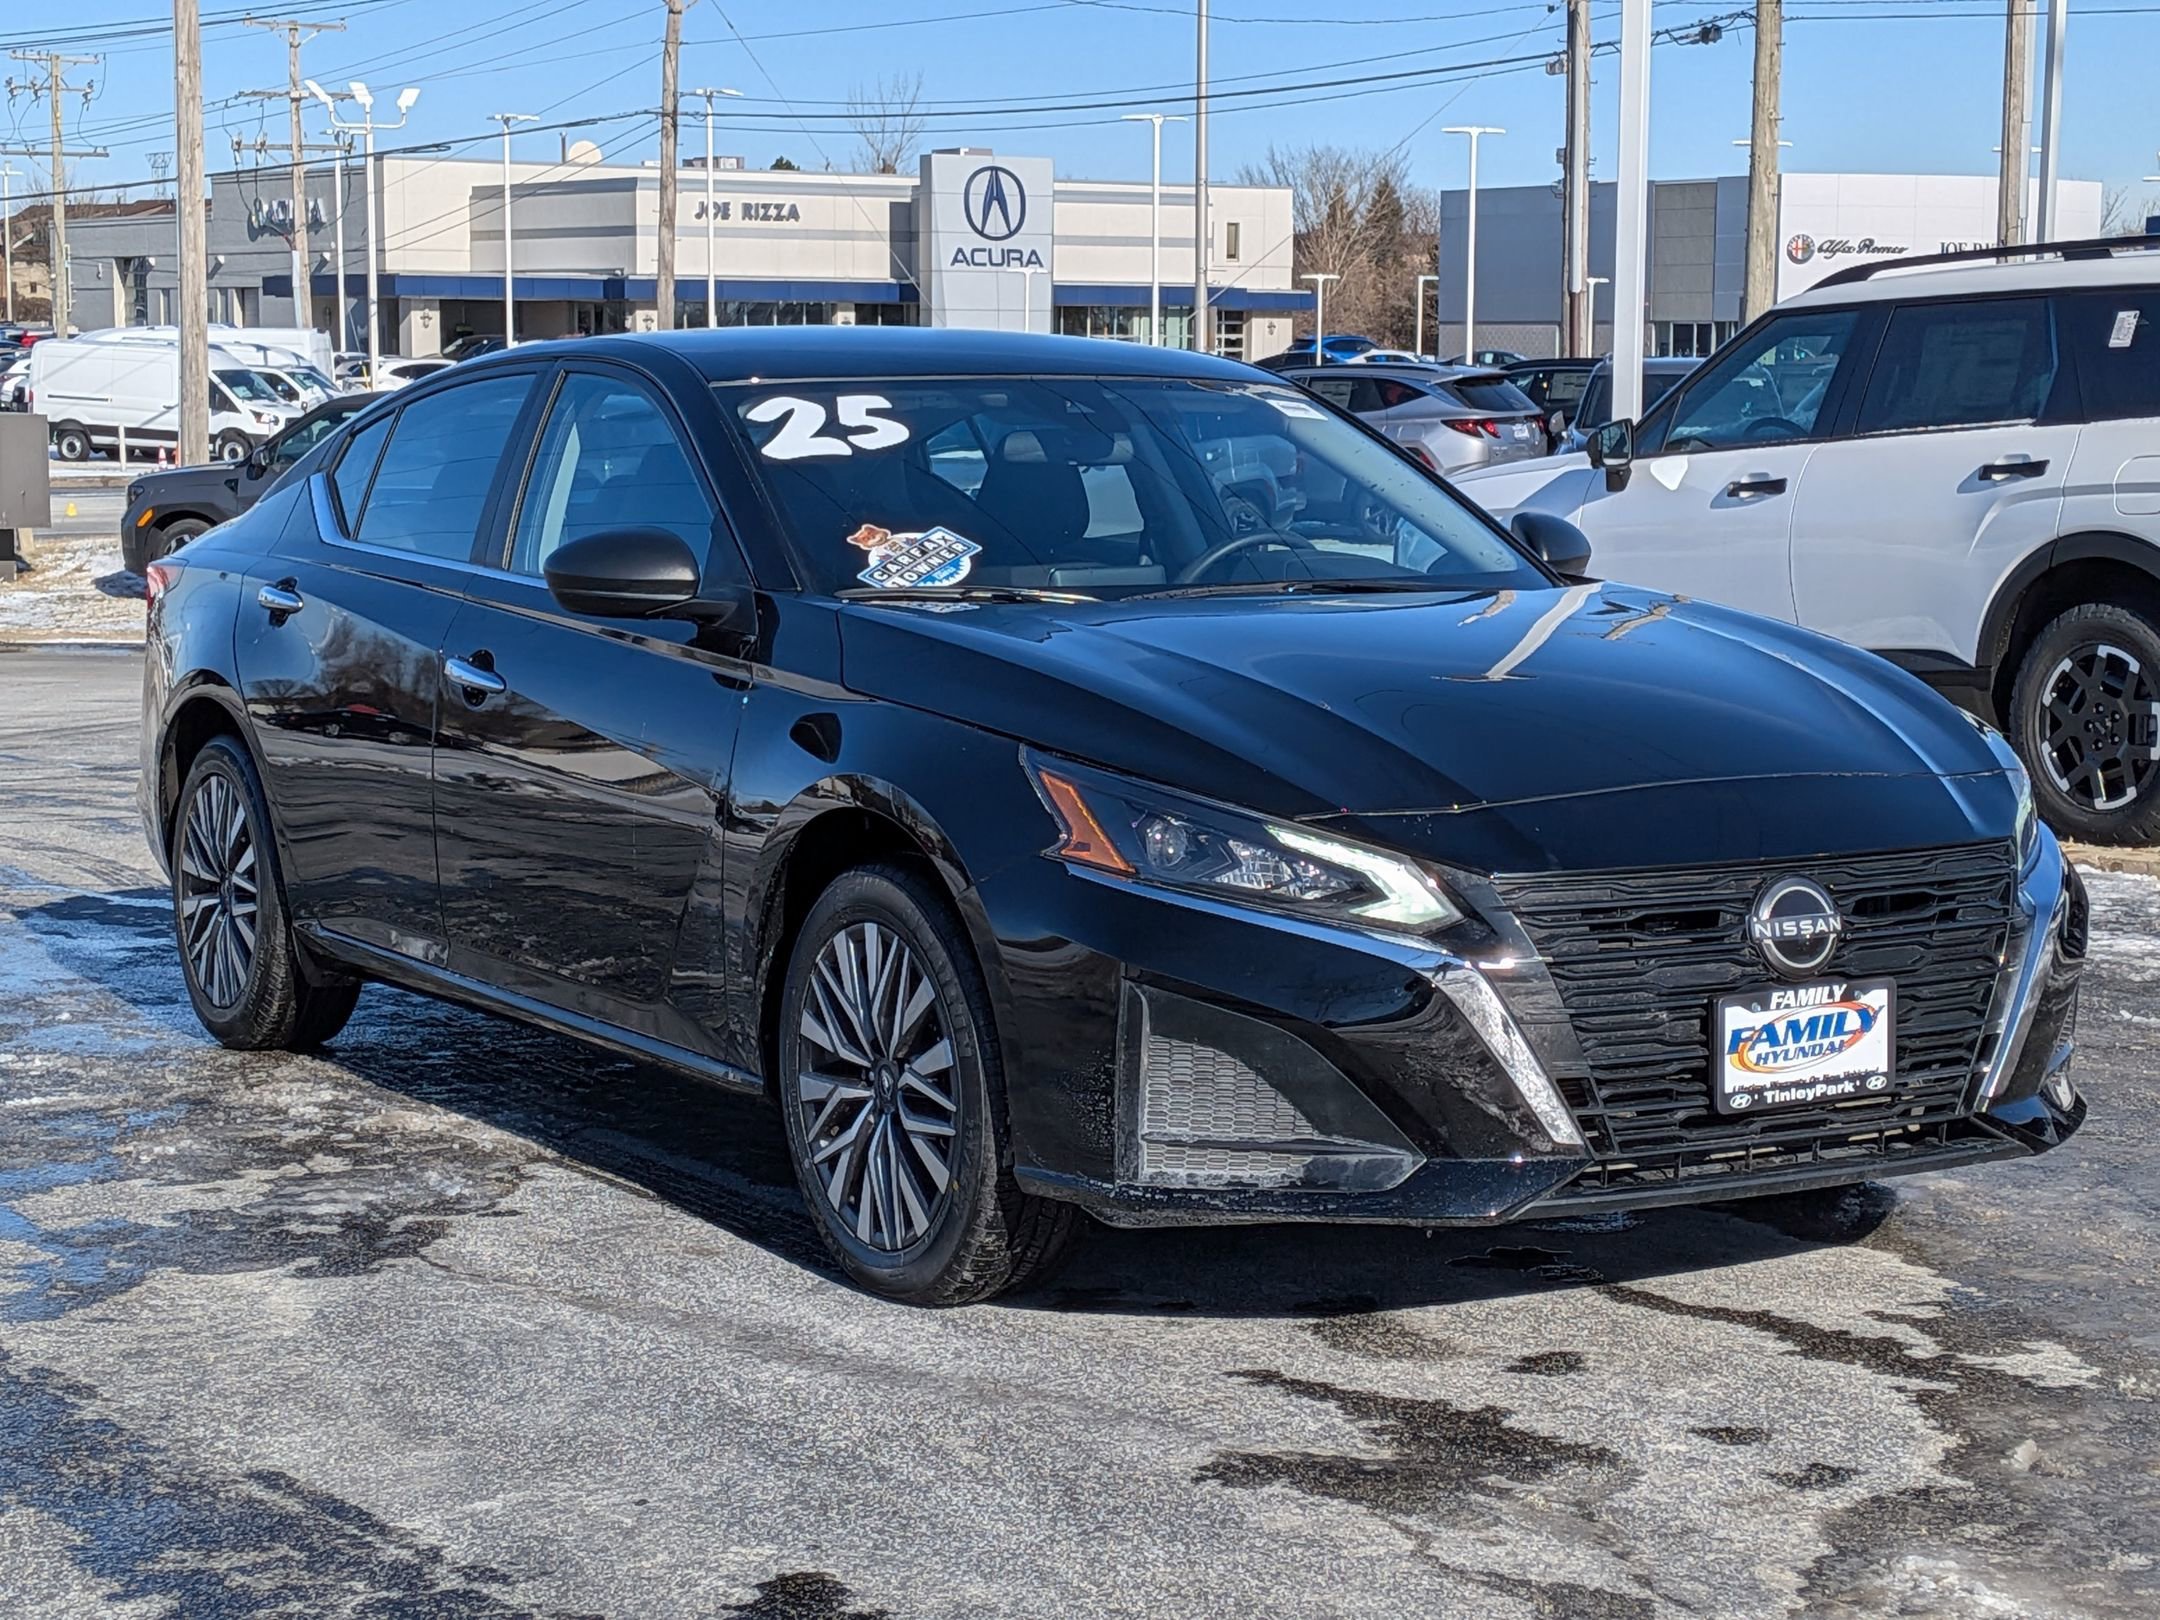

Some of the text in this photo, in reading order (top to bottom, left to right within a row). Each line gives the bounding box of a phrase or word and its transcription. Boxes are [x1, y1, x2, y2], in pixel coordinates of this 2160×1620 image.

[694, 200, 800, 222] JOE RIZZA
[950, 247, 1044, 267] ACURA
[1817, 238, 1856, 260] Alfa
[1857, 237, 1909, 255] Romeo
[746, 395, 910, 460] 25
[872, 535, 953, 581] CARFAX
[902, 542, 969, 582] OWNER
[1754, 916, 1841, 938] NISSAN
[1769, 984, 1847, 1010] FAMILY
[1726, 1005, 1886, 1055] FAMILY
[1754, 1039, 1847, 1066] HYUNDAI
